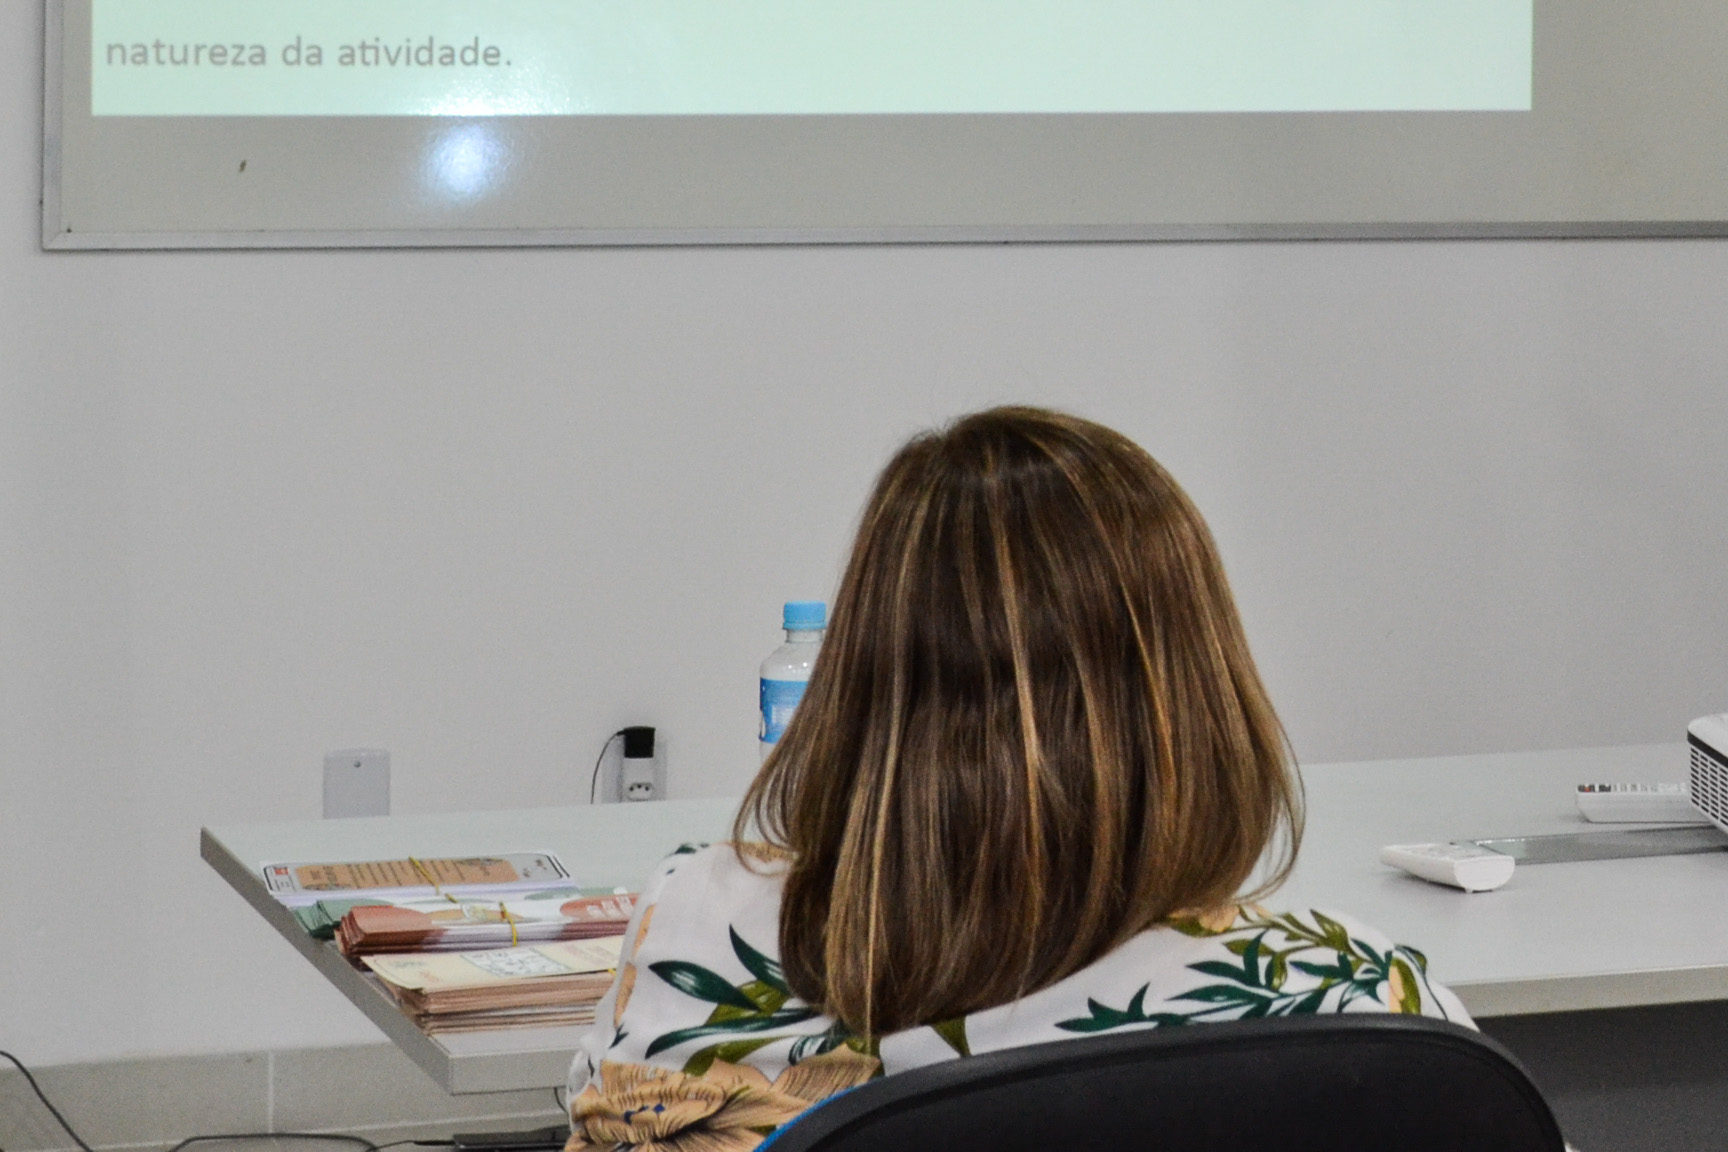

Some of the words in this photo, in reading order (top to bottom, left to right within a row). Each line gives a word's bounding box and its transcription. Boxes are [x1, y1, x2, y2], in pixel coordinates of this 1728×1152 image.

[106, 40, 266, 68] natureza
[281, 37, 323, 68] da
[338, 37, 512, 69] atividade.
